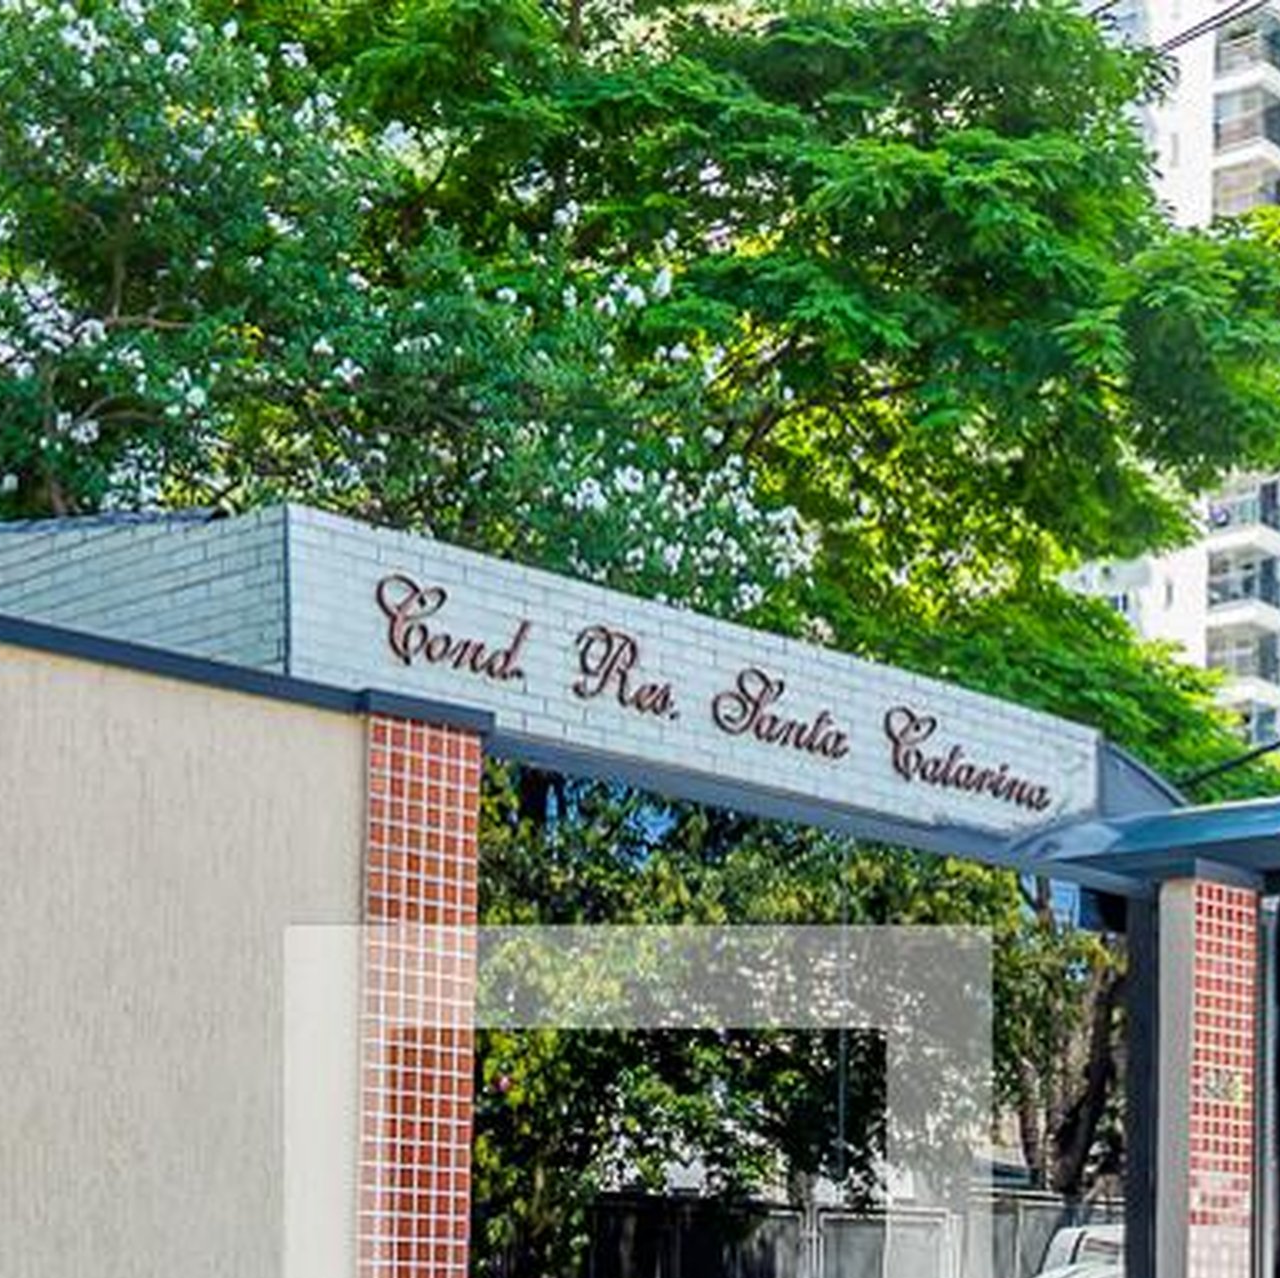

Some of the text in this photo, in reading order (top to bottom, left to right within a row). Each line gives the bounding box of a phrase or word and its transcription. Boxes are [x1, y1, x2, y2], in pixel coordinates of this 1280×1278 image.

[572, 625, 680, 720] Res.
[712, 668, 850, 760] Santa
[883, 706, 1054, 812] Catarina
